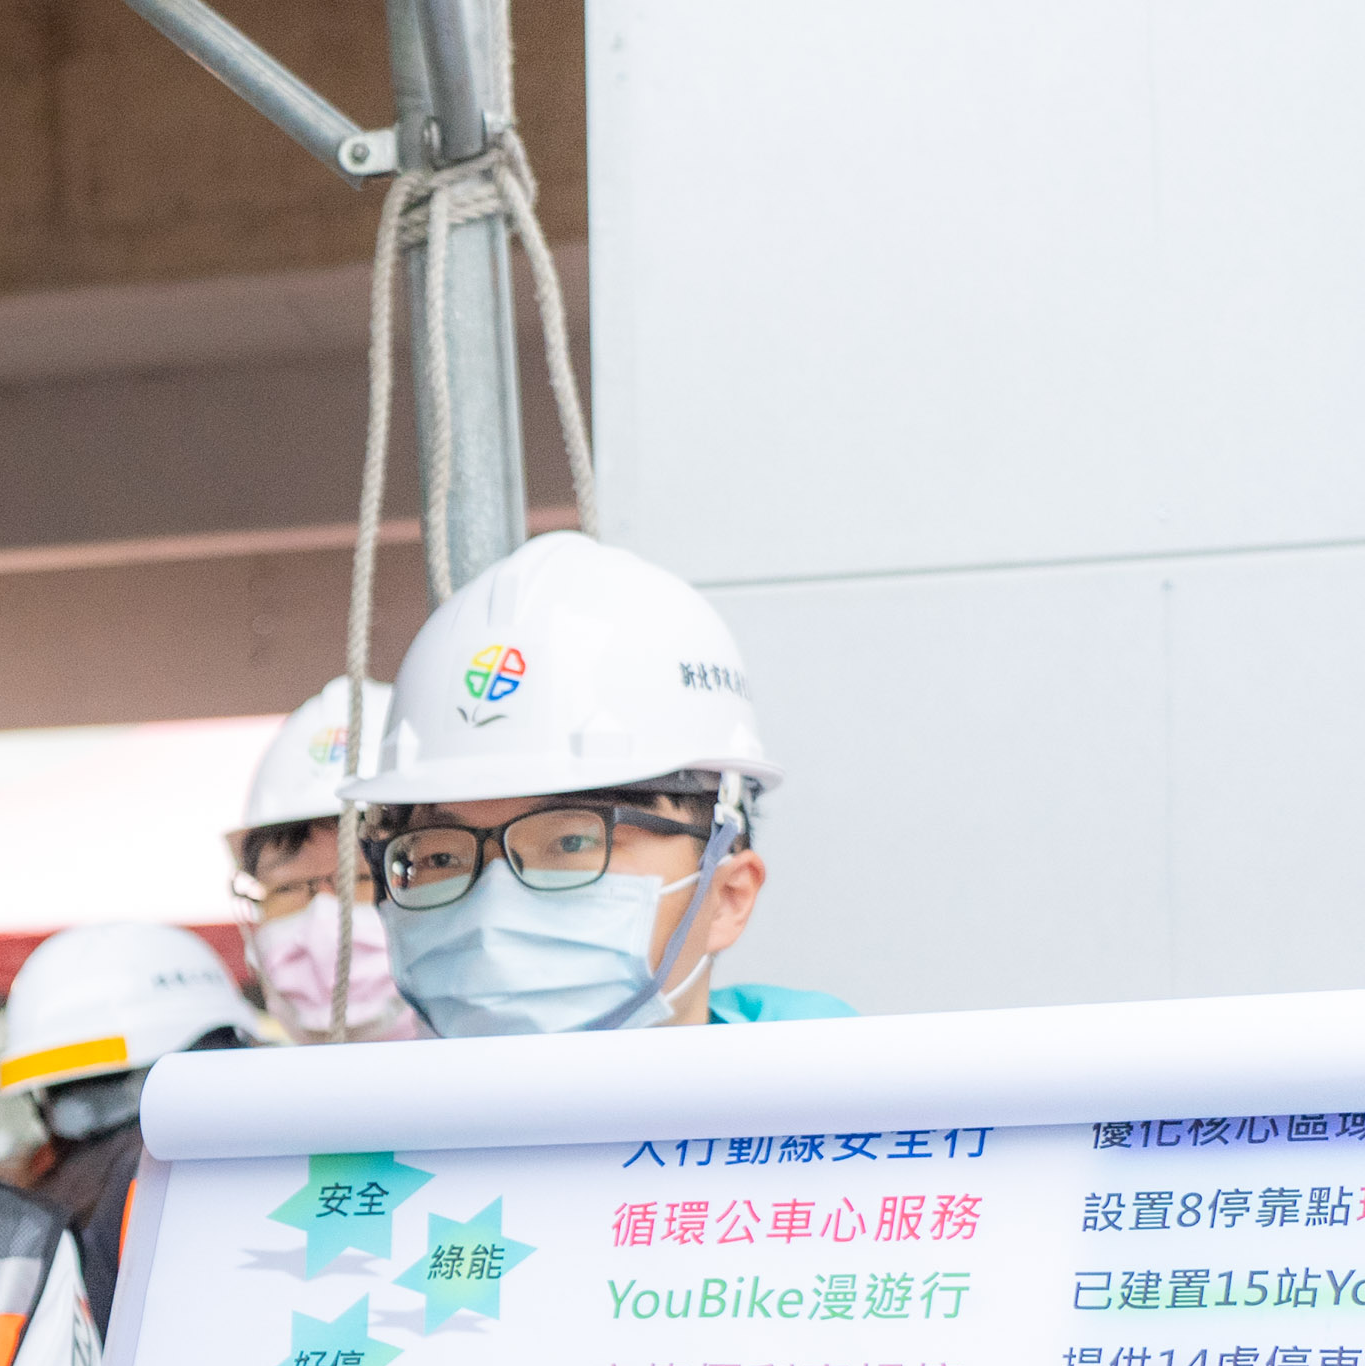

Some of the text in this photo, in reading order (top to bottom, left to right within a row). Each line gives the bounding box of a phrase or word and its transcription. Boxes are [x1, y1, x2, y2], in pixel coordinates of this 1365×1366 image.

[315, 1182, 390, 1218] 安全
[611, 1192, 983, 1248] 循環公車心服務
[1082, 1185, 1365, 1232] 設置8停靠點
[427, 1243, 505, 1281] 綠能
[607, 1271, 971, 1321] YouBike漫遊行
